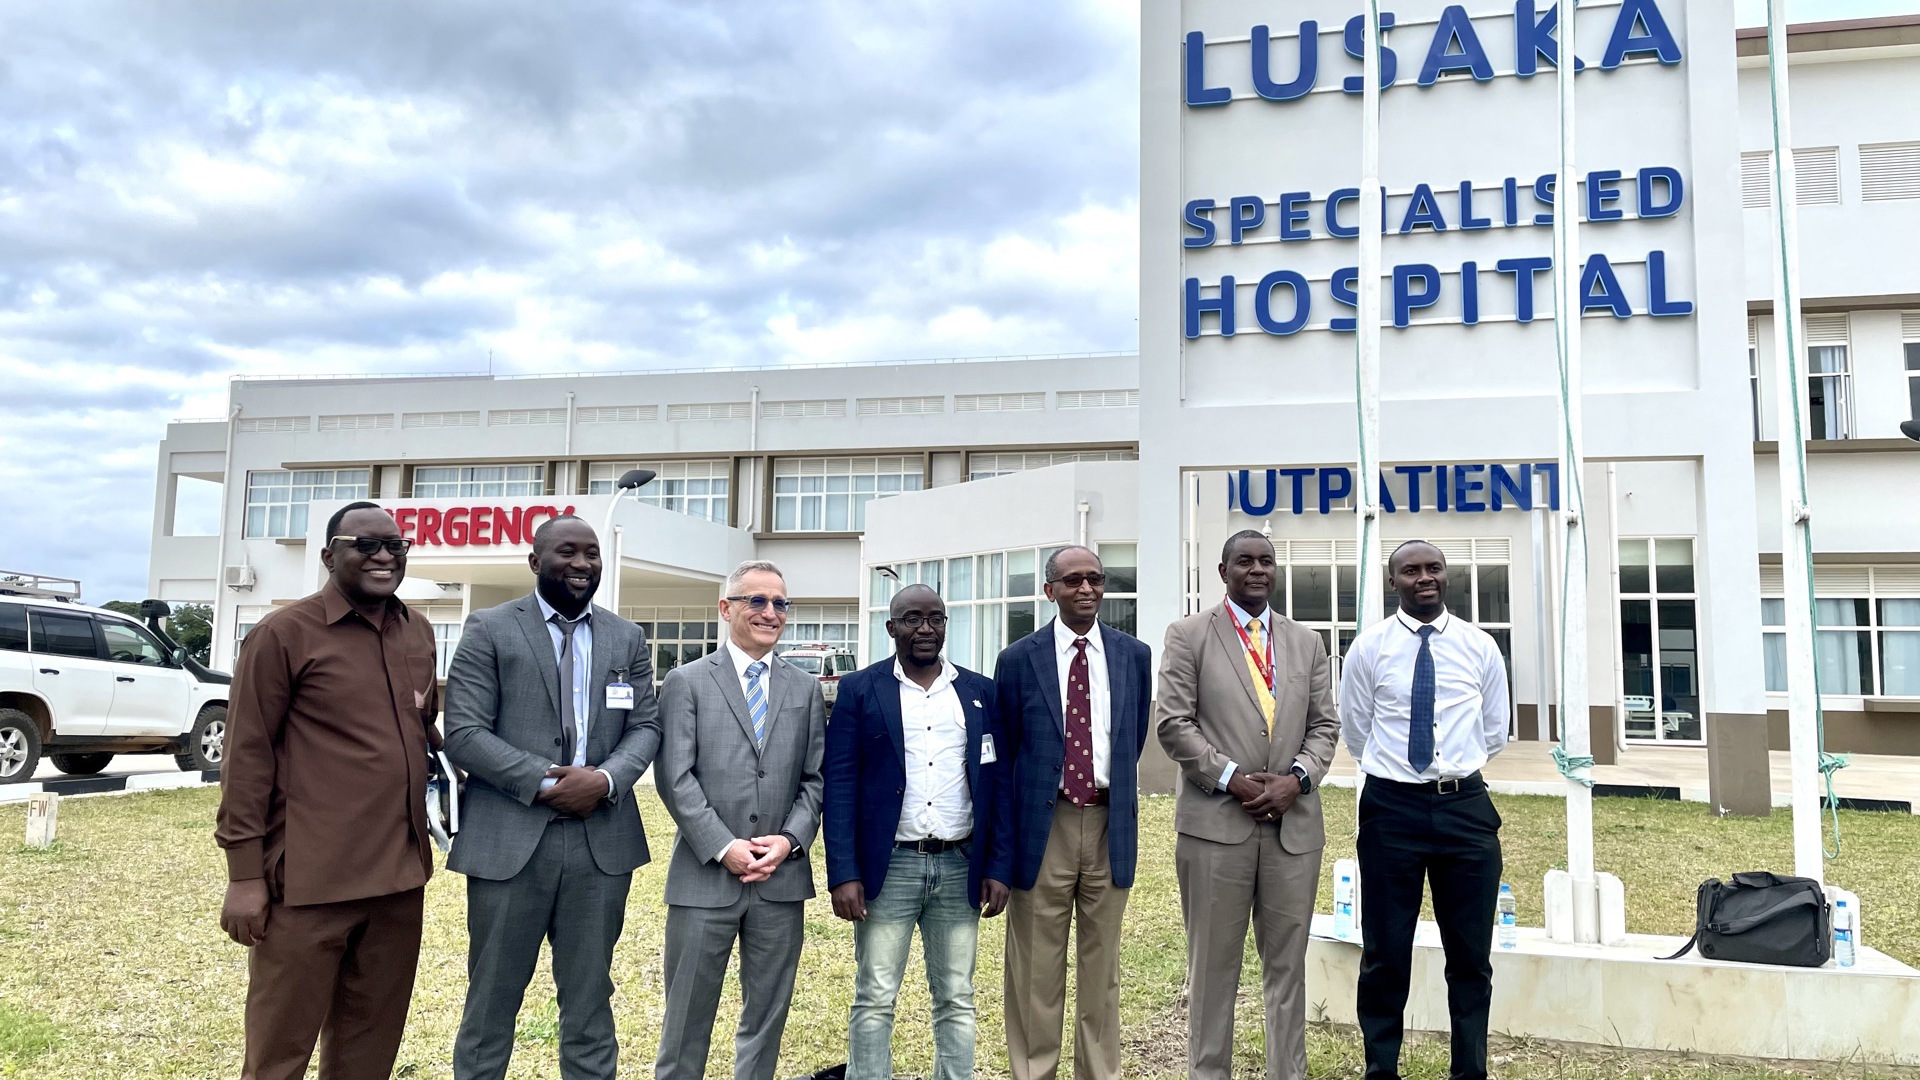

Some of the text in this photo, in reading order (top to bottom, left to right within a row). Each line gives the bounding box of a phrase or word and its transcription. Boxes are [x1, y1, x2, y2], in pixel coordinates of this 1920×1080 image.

[1185, 0, 1682, 108] LUSAKA
[1184, 250, 1694, 338] HOSPITAL
[1197, 463, 1559, 516] UTPTIENT
[29, 799, 48, 817] FW
